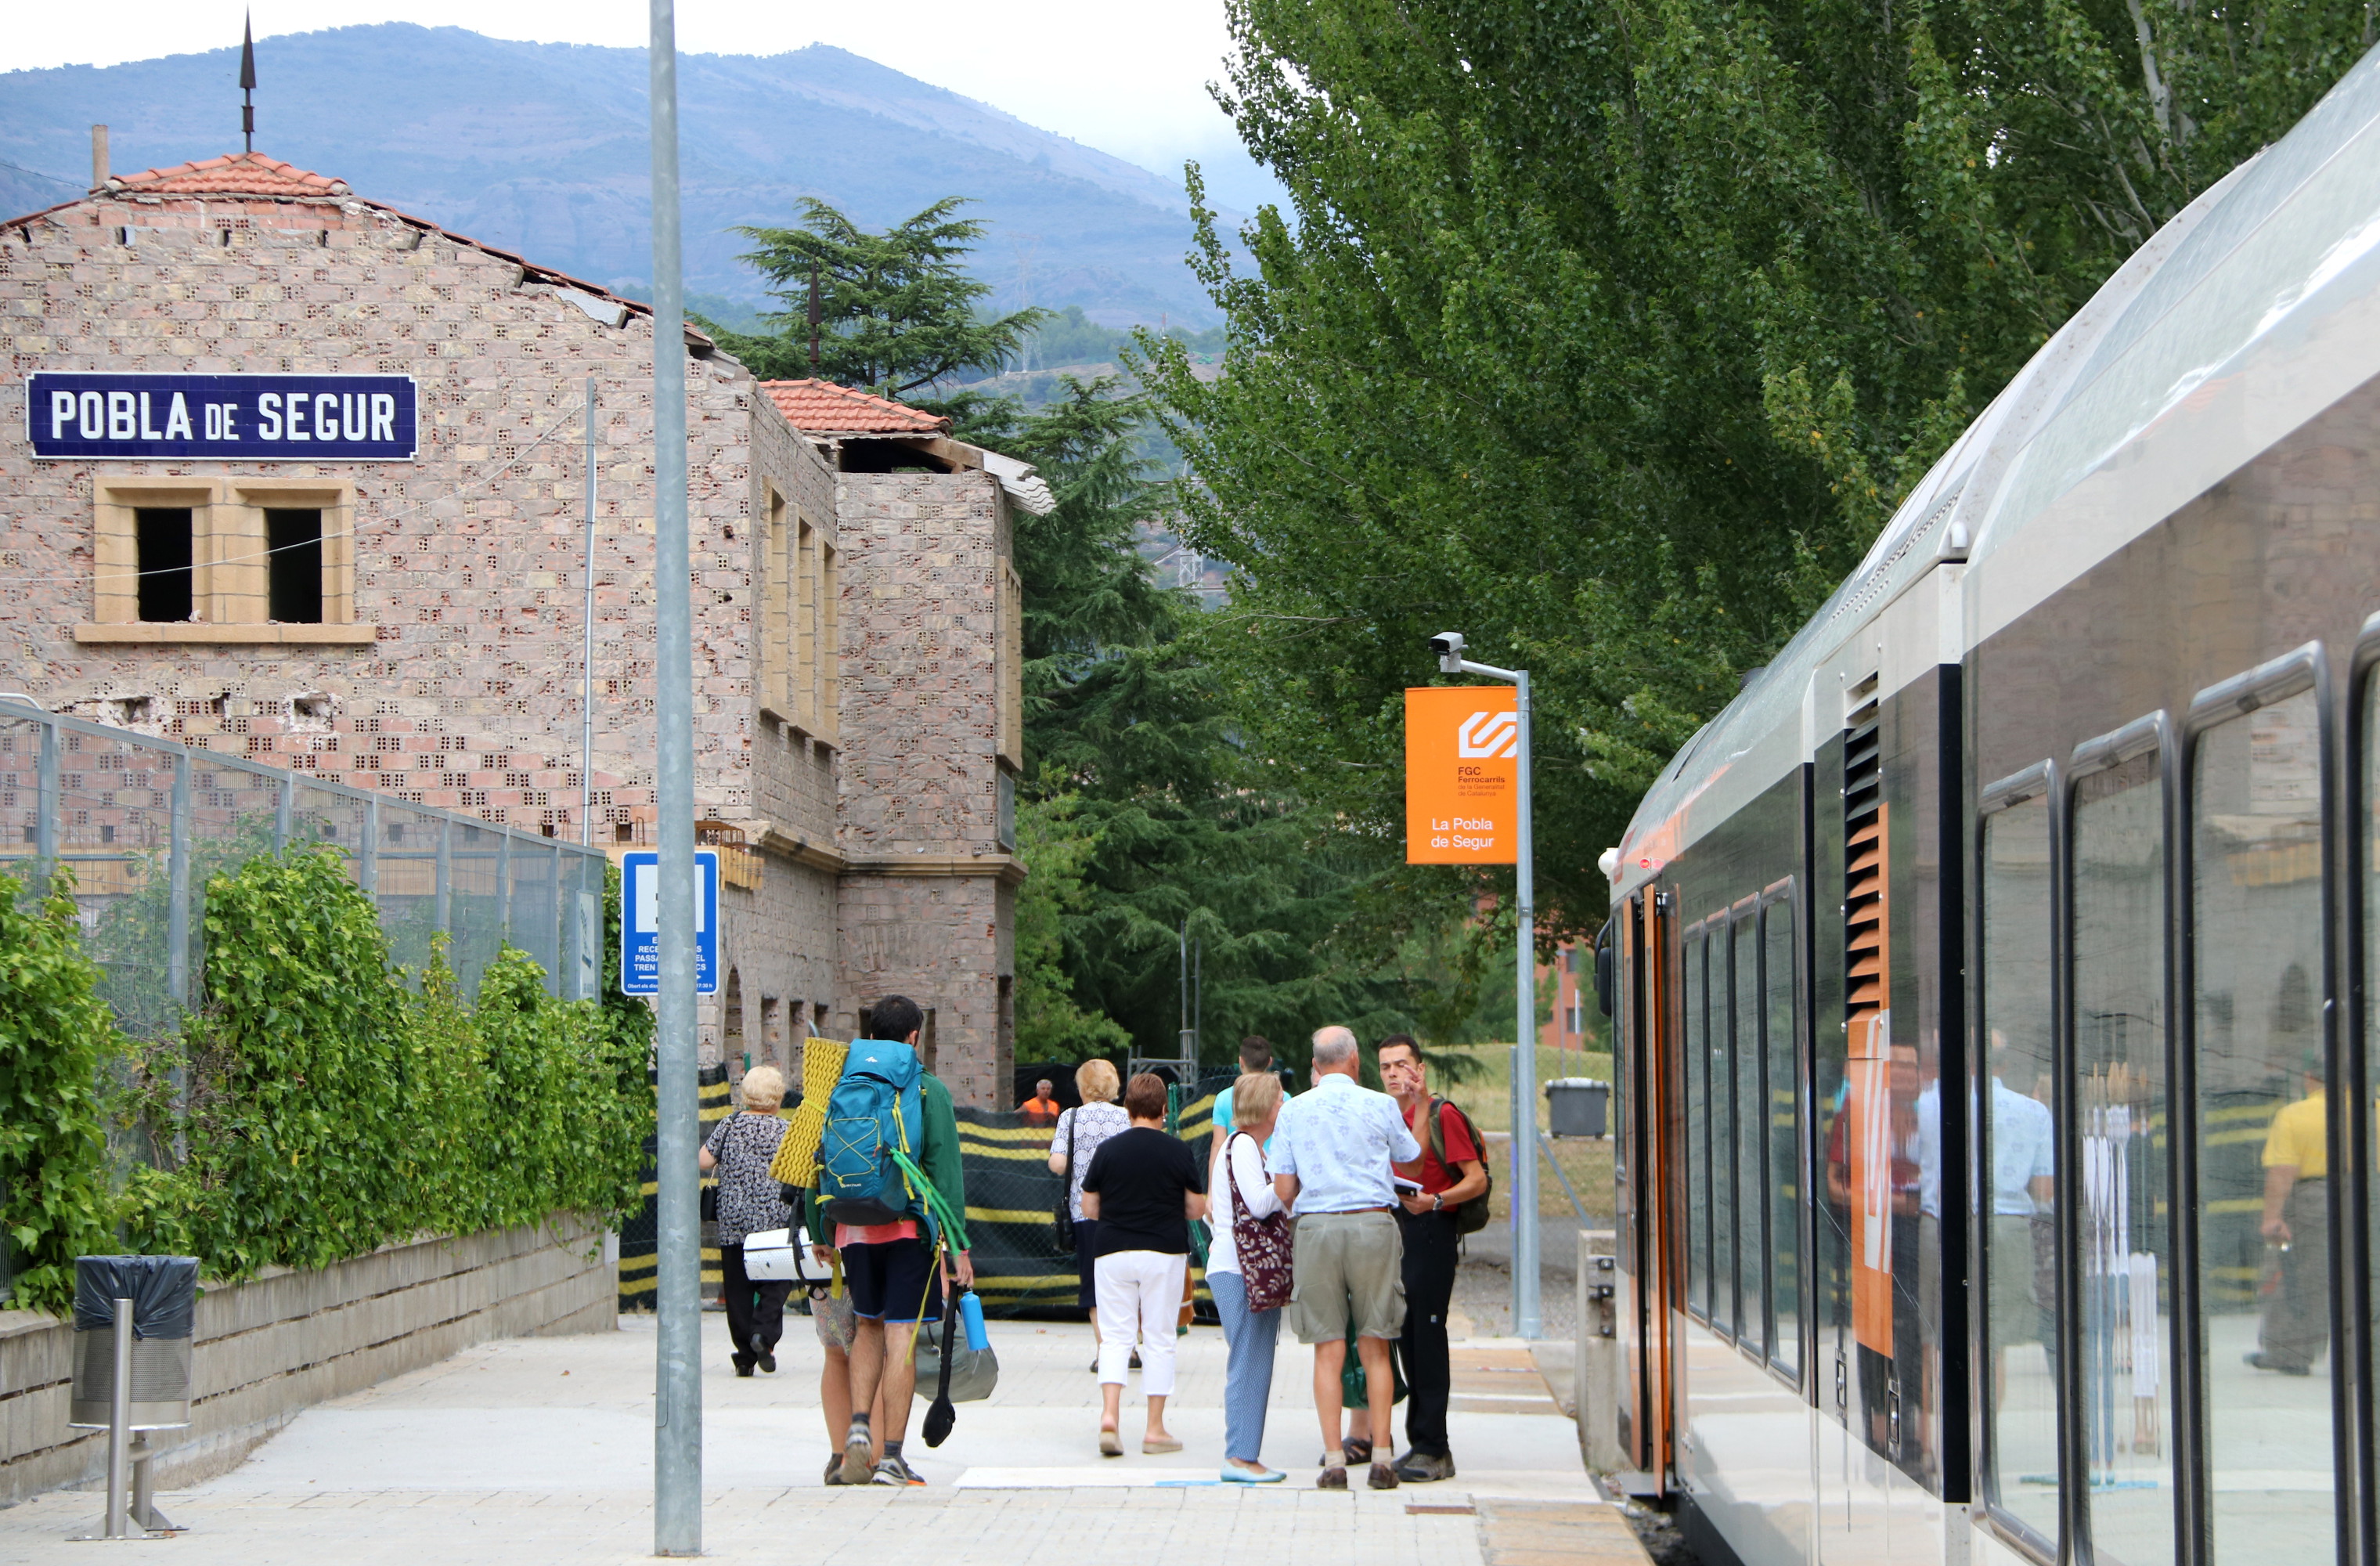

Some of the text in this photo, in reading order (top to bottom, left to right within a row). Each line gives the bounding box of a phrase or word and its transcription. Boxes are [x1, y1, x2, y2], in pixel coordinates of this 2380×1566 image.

[52, 391, 395, 442] POBLA DE SEGUR
[1458, 767, 1480, 775] FGC
[1432, 817, 1493, 830] La Pobla
[1431, 835, 1494, 850] de Segur
